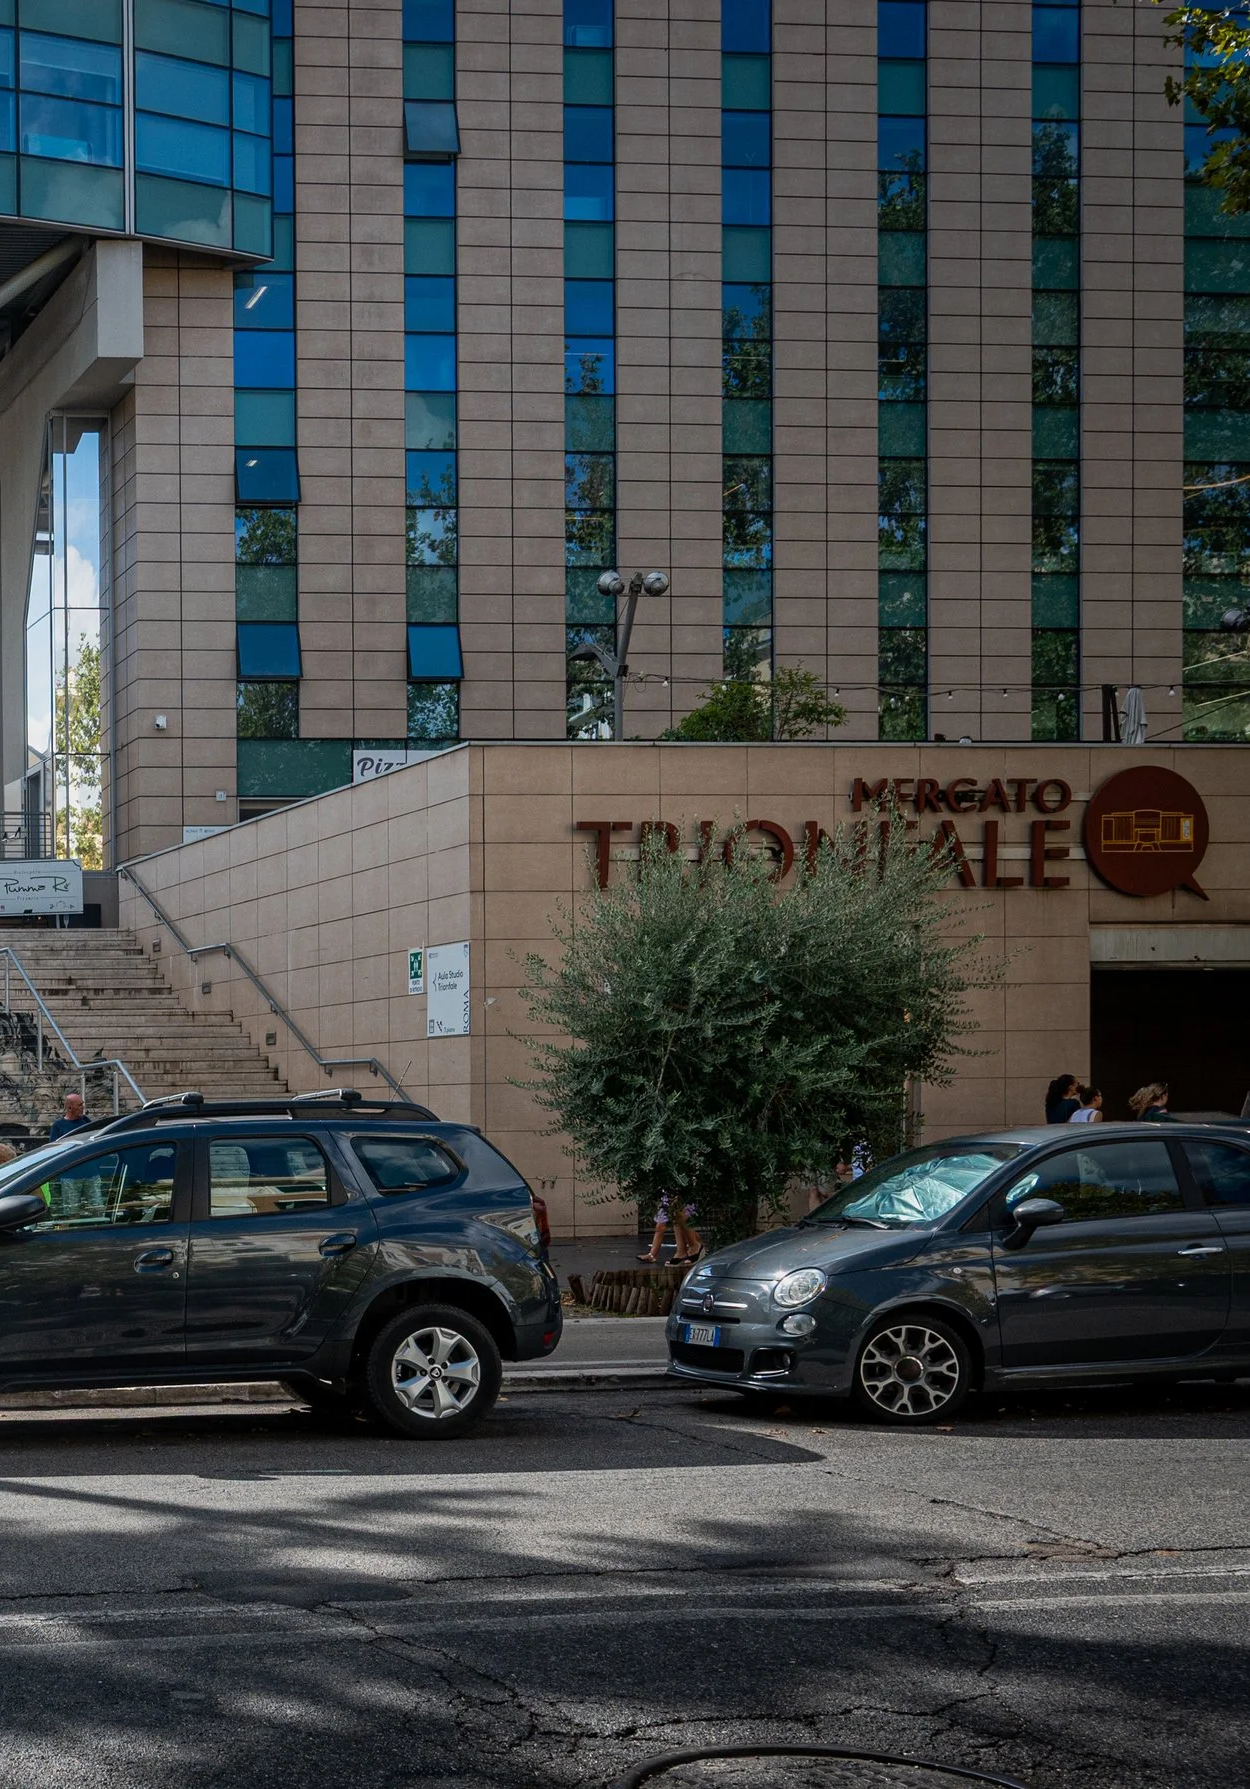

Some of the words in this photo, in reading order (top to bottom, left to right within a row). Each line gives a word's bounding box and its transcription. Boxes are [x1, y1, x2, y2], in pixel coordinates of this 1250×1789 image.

[852, 777, 1072, 813] MERCATO
[438, 972, 448, 980] Aula
[449, 969, 463, 979] Studio
